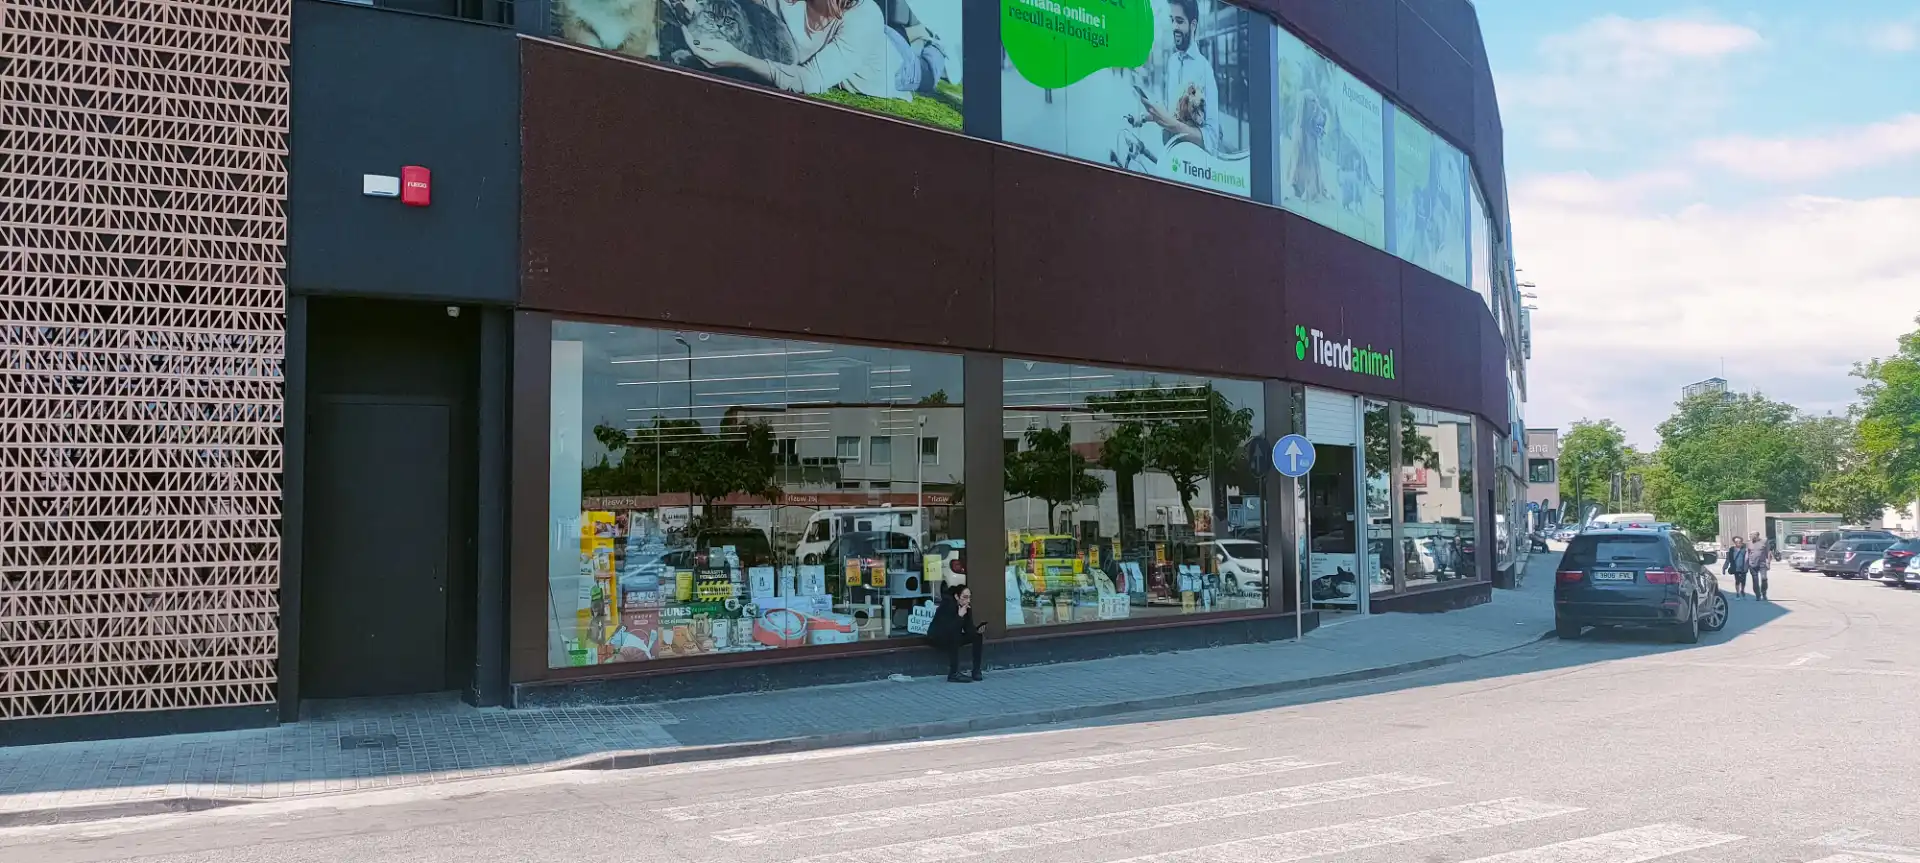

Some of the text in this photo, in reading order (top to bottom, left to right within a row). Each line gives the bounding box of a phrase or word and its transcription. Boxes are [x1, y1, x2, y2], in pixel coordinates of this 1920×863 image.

[1008, 6, 1109, 48] recull a la botiga!
[1063, 6, 1101, 28] online
[1101, 15, 1106, 29] i
[1182, 160, 1245, 188] Tiendanimal
[1310, 328, 1395, 380] Tiendanimal
